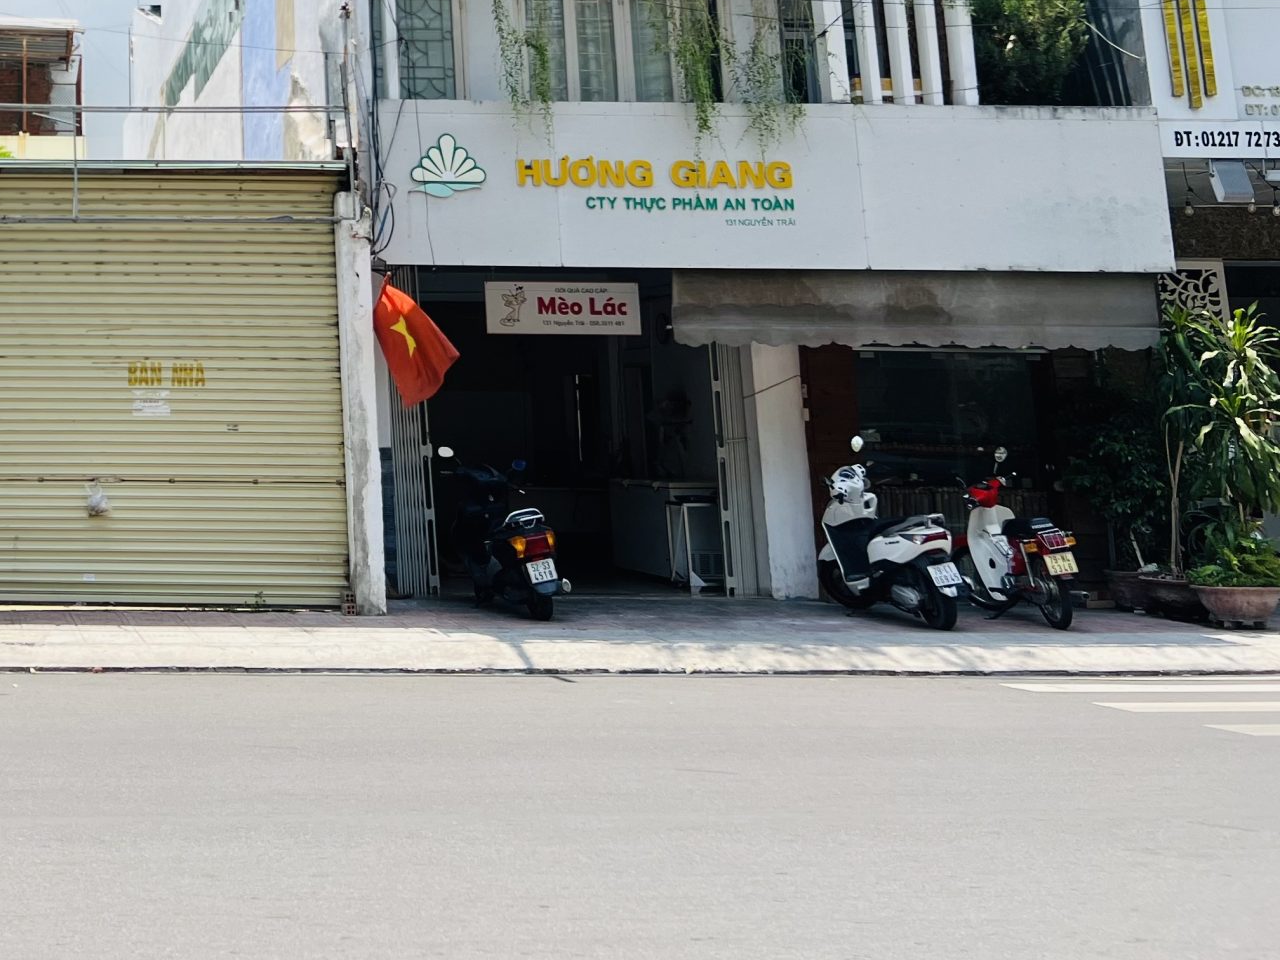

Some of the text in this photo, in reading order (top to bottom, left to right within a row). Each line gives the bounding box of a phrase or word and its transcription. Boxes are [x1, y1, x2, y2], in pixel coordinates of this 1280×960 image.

[516, 155, 793, 190] HƯƠNG GIANG
[585, 196, 617, 210] CTY
[623, 196, 667, 213] THỰC
[723, 198, 746, 211] AN
[751, 195, 795, 211] TOÀN
[725, 219, 737, 227] 131
[537, 297, 627, 315] Mèo Lác
